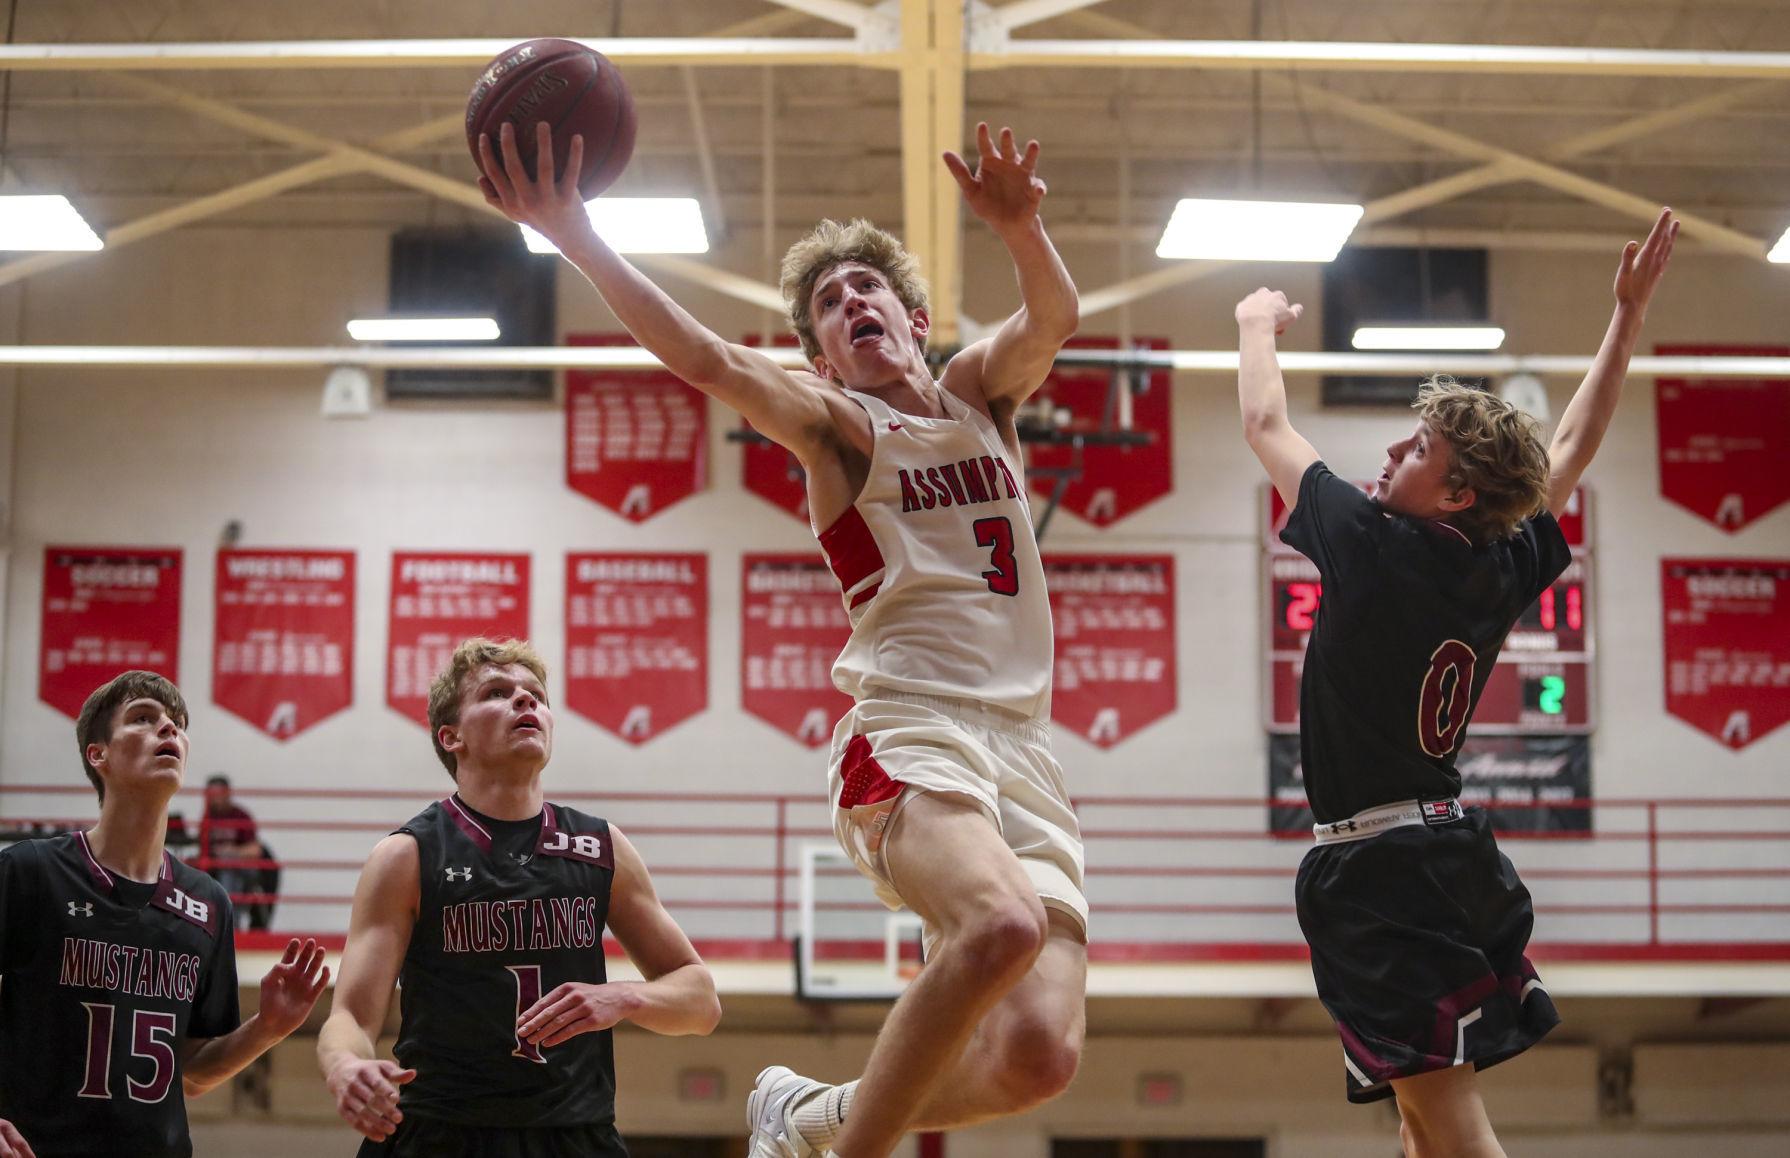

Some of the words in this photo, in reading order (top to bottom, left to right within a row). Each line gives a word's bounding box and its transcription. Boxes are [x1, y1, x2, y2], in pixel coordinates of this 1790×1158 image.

[898, 455, 1022, 513] ASSUMPT
[973, 516, 1019, 597] 3
[1286, 582, 1322, 631] 2
[1539, 584, 1582, 631] 11
[1418, 638, 1477, 759] 0
[1539, 674, 1566, 715] 2
[543, 831, 601, 859] JB
[166, 887, 209, 924] JB
[443, 896, 596, 953] MUSTANGS
[60, 937, 200, 1003] MUSTANGS
[503, 964, 547, 1064] 1
[77, 1001, 177, 1104] 15
